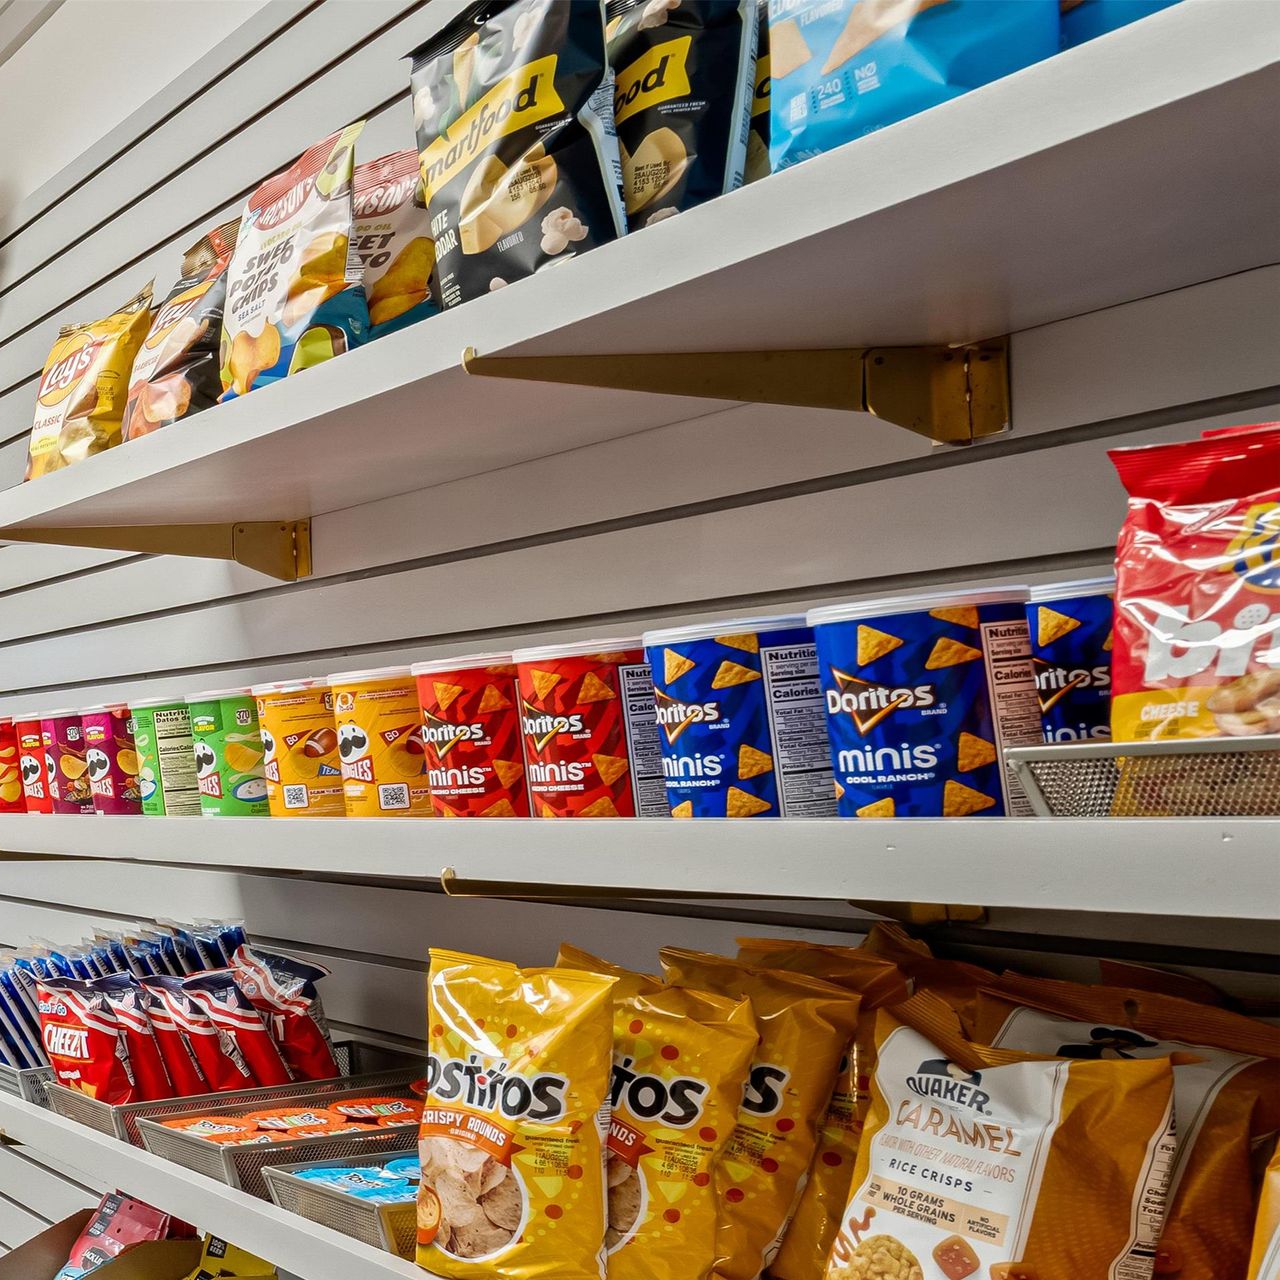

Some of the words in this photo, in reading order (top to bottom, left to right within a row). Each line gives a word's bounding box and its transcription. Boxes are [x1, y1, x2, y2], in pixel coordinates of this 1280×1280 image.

[817, 78, 841, 99] 240
[496, 230, 525, 253] FLAVORED
[231, 272, 278, 314] CHIPS
[38, 344, 95, 397] Lay's
[33, 413, 62, 431] CLASSIC
[773, 686, 820, 699] Calories
[826, 686, 936, 715] Doritos
[236, 710, 249, 720] 370
[1141, 701, 1200, 720] CHEESE
[386, 729, 399, 740] GO
[422, 724, 484, 743] Doritos
[523, 714, 583, 735] Doritos
[288, 734, 299, 745] GO
[839, 744, 938, 773] minis
[846, 774, 879, 783] COOL
[879, 772, 929, 782] RANCH
[905, 1076, 991, 1114] QUAKER
[422, 1111, 463, 1127] CRISPY
[896, 1099, 1022, 1157] CARAMEL
[467, 1118, 506, 1147] ROUNDS
[888, 1158, 917, 1175] RICE
[921, 1168, 973, 1192] CRISPS
[883, 1191, 914, 1210] WHOLE
[916, 1203, 956, 1223] GRAINS
[897, 1186, 908, 1196] 10
[909, 1190, 945, 1208] GRAMS
[892, 1205, 905, 1215] PER
[906, 1210, 937, 1225] SERVING
[967, 1219, 1000, 1234] ARTIFICIAL
[968, 1225, 996, 1239] FLAVORS
